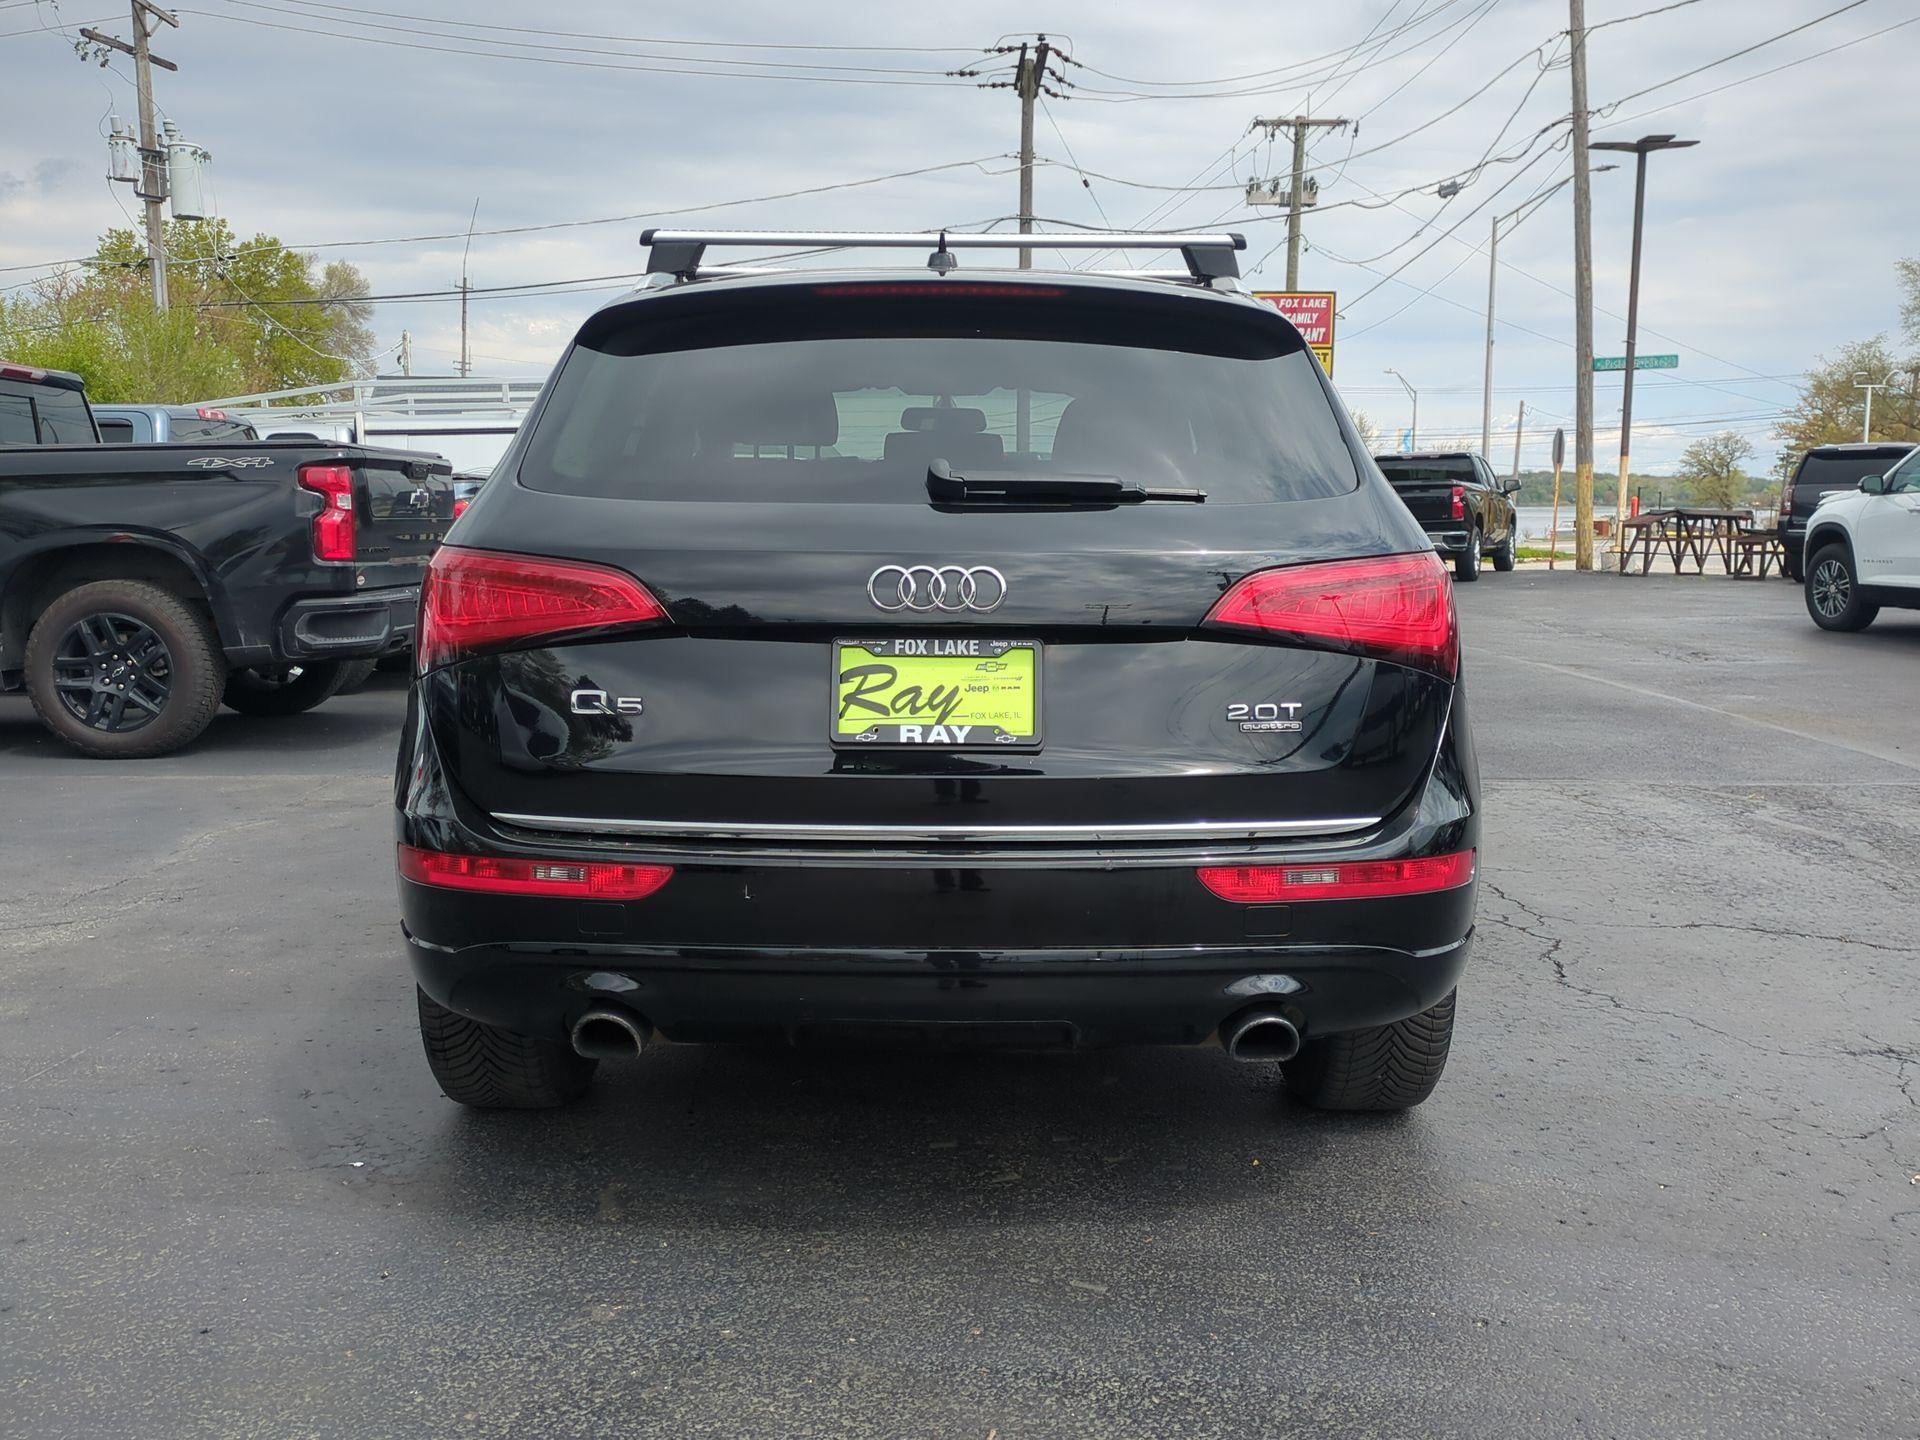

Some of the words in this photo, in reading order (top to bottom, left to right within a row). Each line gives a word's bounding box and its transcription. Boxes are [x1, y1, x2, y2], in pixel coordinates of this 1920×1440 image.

[1279, 298, 1300, 308] FOX
[1302, 298, 1328, 308] LAKE
[895, 640, 927, 655] FOX
[934, 640, 979, 655] LAKE
[839, 664, 963, 726] Ray
[964, 684, 990, 693] Jeep
[571, 689, 643, 715] Q5
[970, 712, 986, 720] FOX
[988, 711, 1012, 720] LAKE,
[1014, 711, 1022, 719] IL
[1227, 702, 1302, 720] 2.0T
[900, 725, 973, 744] RAY
[1242, 723, 1300, 731] quattro
